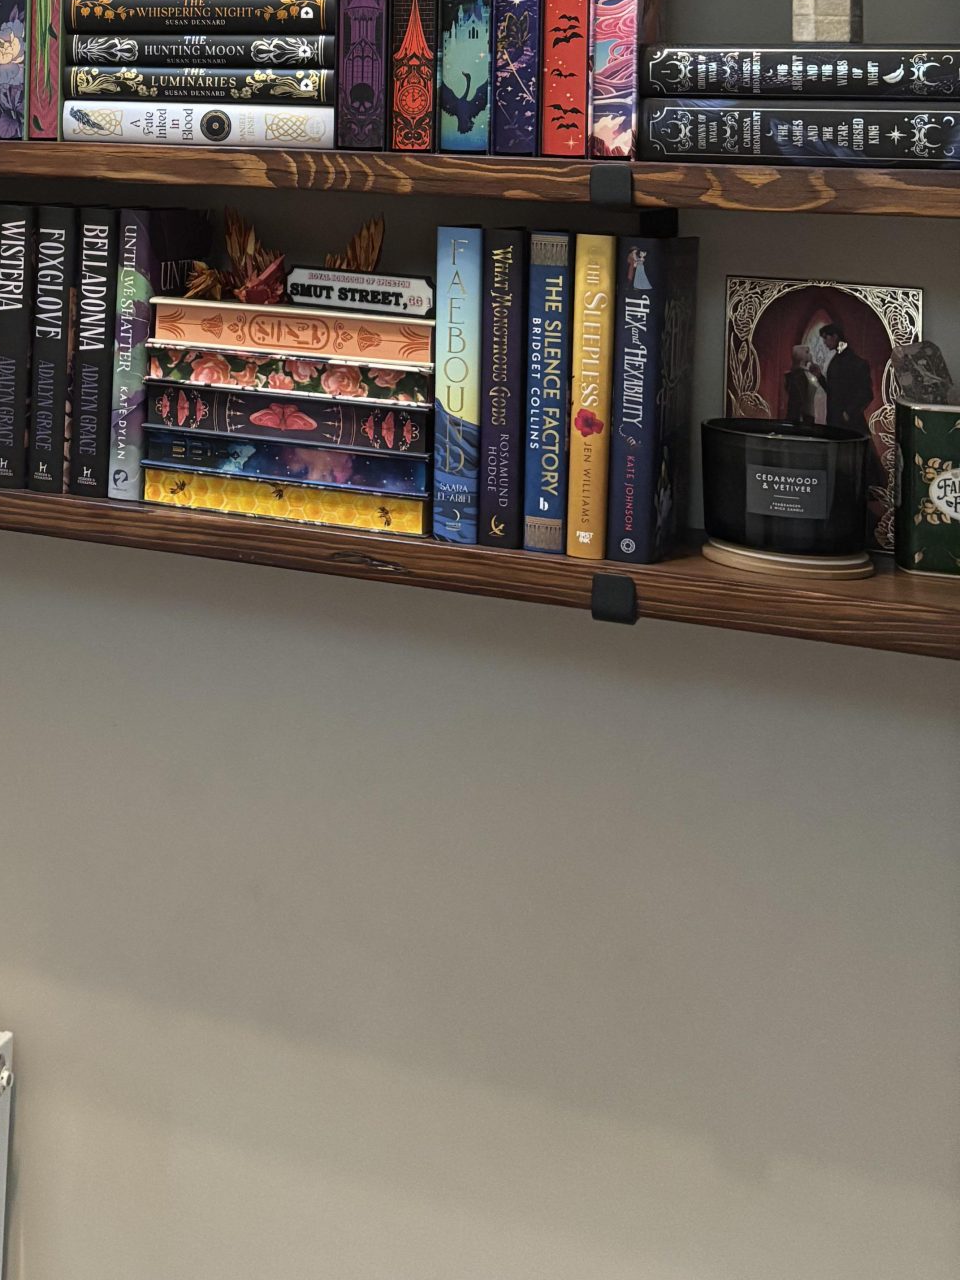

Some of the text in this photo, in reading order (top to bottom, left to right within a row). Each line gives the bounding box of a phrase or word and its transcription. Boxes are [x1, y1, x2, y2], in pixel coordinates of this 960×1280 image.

[136, 7, 254, 18] WHISPERING NIGHT
[145, 46, 245, 56] HUNTING MOON
[184, 36, 207, 44] THE
[151, 77, 237, 87] LUMINARIES
[743, 58, 751, 87] CARISSA
[837, 60, 848, 86] WINGS
[852, 68, 863, 79] OF
[868, 61, 878, 86] NIGHT
[130, 119, 141, 127] A
[143, 112, 154, 135] Fate
[157, 109, 167, 139] Inked
[182, 108, 193, 140] Blood
[743, 117, 751, 147] CARISSA
[777, 125, 789, 141] THE
[792, 120, 803, 146] ASHES
[808, 125, 819, 141] AND
[823, 127, 834, 142] THE
[852, 118, 864, 151] CURSED
[868, 125, 880, 144] KING
[35, 228, 66, 340] FOXGLOVE
[79, 224, 109, 350] BELLADONNA
[290, 283, 408, 309] SMUT STREET,
[116, 299, 134, 372] SHATTER
[488, 246, 513, 426] WHAT MONSTROUS GODS
[581, 291, 607, 407] SLEEPLESS
[444, 239, 469, 476] FAEBOUND
[622, 295, 650, 428] HEX HEXABILITY
[37, 360, 54, 408] ADALYN
[80, 364, 99, 411] ADALYN
[529, 318, 542, 449] BRIDGET COLLINS
[541, 276, 563, 496] THE SILENCE FACTORY
[35, 410, 53, 451] GRACE
[79, 415, 97, 455] GRACE
[116, 387, 128, 459] KATE DYLAN
[583, 442, 593, 462] JEN
[487, 446, 499, 492] HODGE
[498, 434, 510, 507] ROSAMUND
[756, 474, 818, 484] CEDARWOOD
[580, 466, 592, 524] WILLIAMS
[623, 455, 635, 530] KATE JOHNSON
[774, 484, 811, 492] VETIVER
